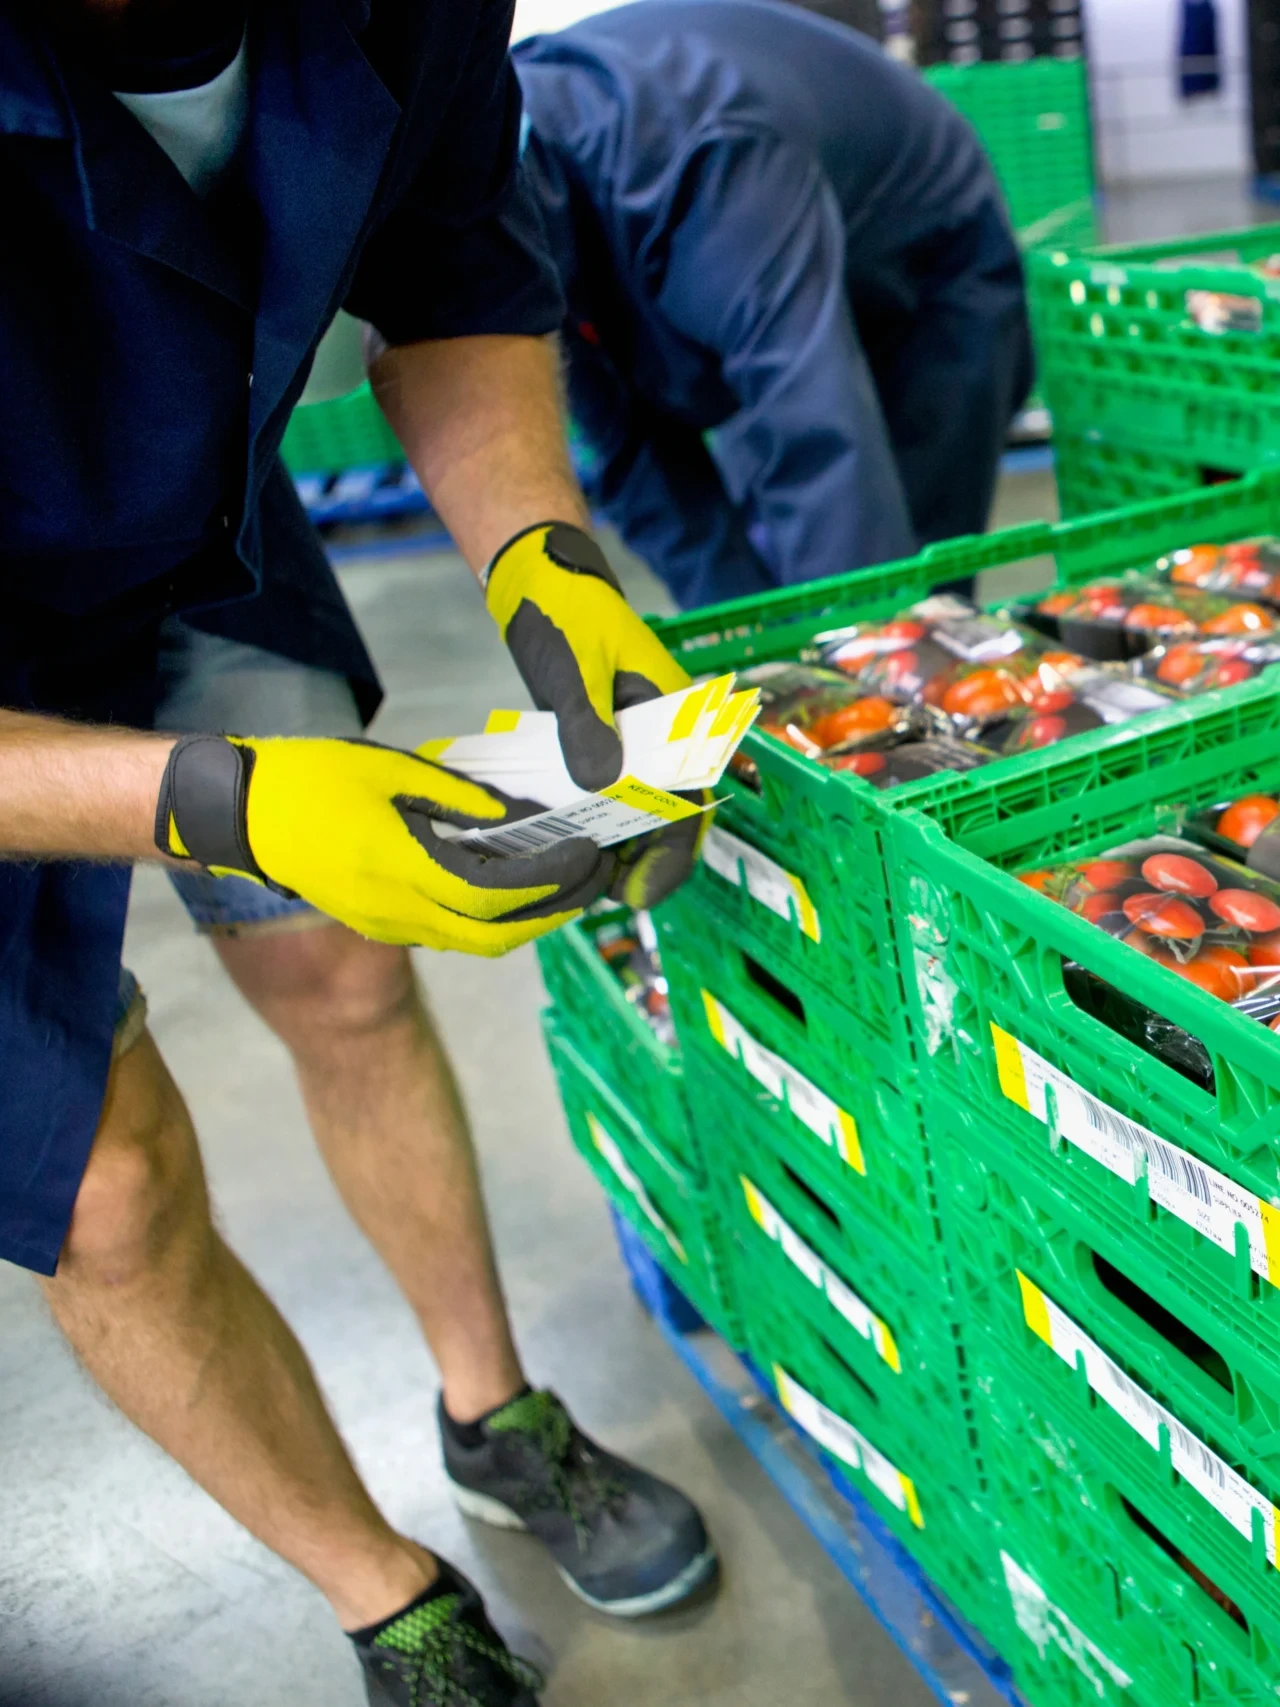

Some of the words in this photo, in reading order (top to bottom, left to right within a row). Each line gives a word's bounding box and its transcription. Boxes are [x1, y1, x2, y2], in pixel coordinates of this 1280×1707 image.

[628, 784, 654, 796] KEEP
[1208, 1177, 1225, 1195] LINE
[1226, 1190, 1239, 1203] NO
